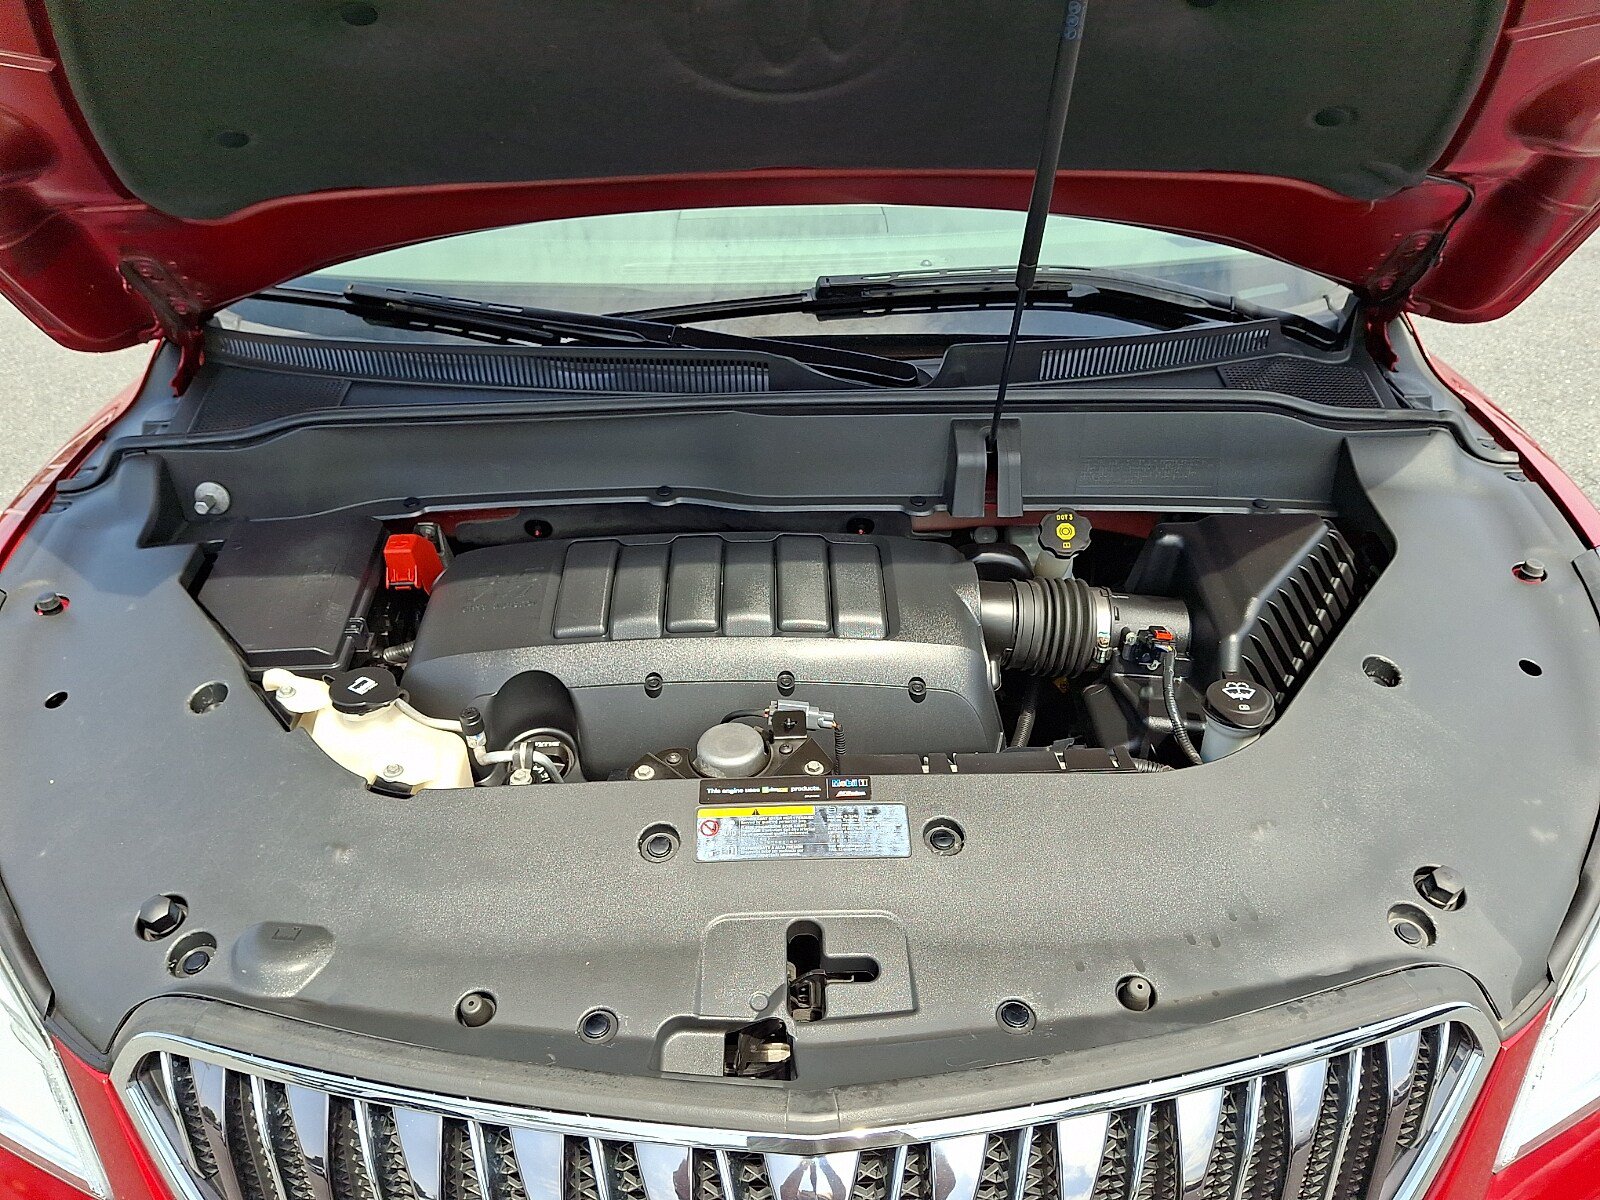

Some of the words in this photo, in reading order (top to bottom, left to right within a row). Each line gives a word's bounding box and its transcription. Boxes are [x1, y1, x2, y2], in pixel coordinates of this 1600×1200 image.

[831, 779, 858, 787] Mobil
[722, 787, 744, 795] engine
[790, 785, 822, 794] products.
